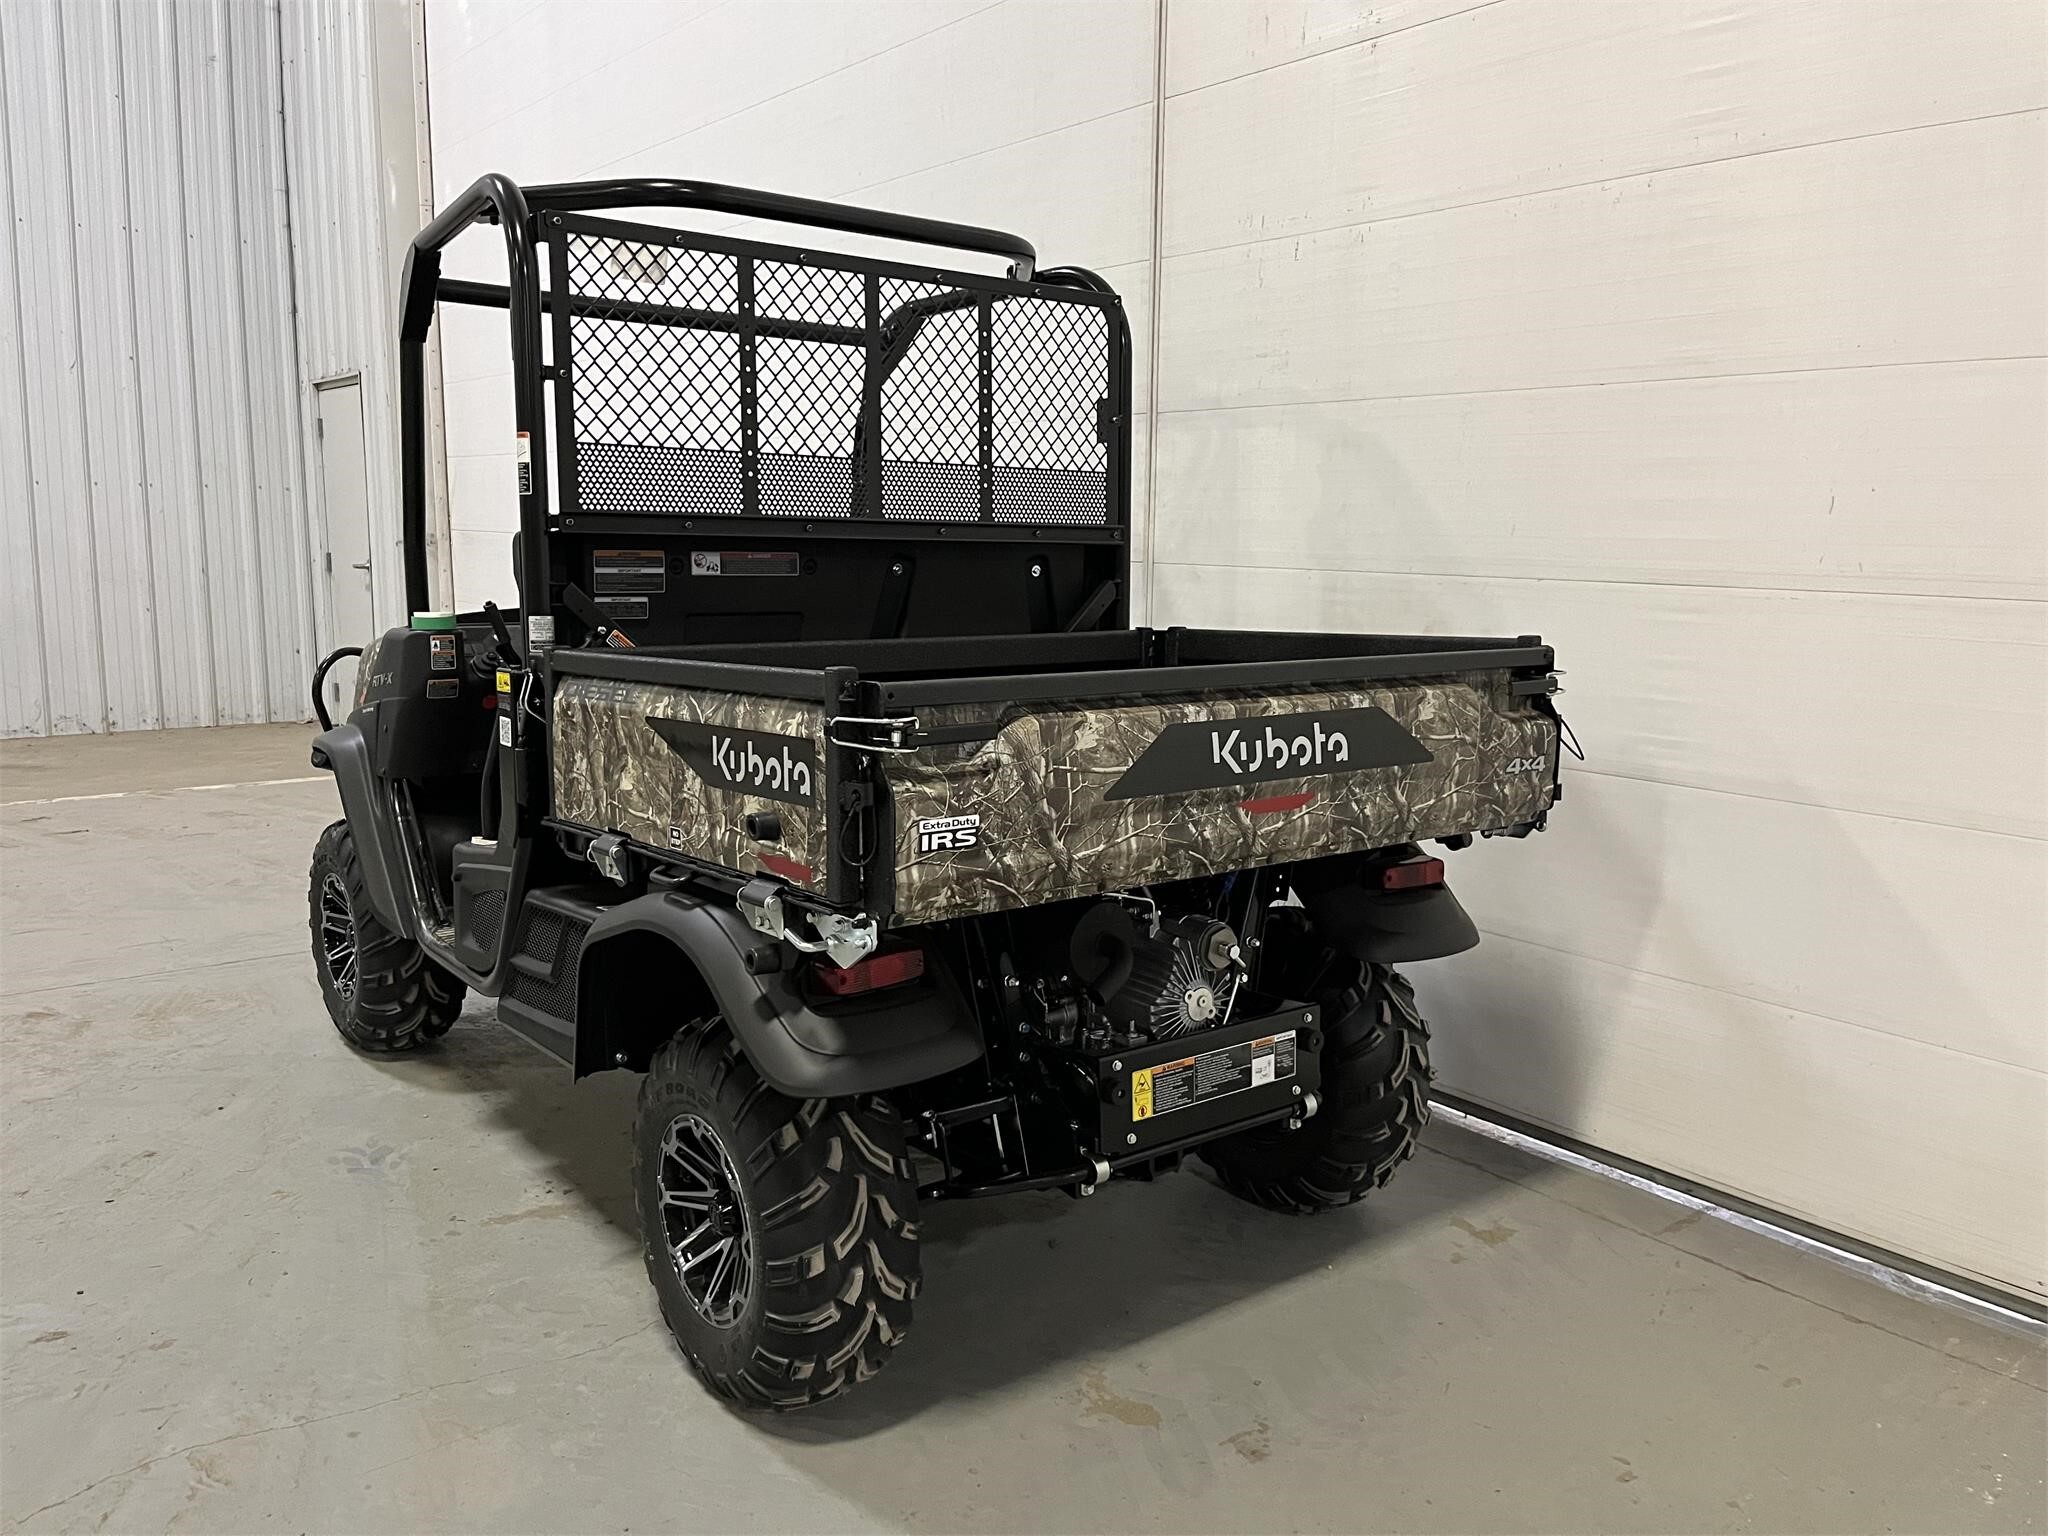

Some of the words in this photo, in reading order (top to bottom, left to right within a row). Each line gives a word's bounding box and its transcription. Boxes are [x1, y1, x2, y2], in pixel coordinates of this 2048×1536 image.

[1211, 722, 1349, 774] Kubota
[712, 735, 811, 796] Kubota
[1505, 755, 1546, 775] 4x4
[923, 821, 950, 830] Extra
[952, 818, 977, 827] Duty
[921, 828, 977, 852] IRS
